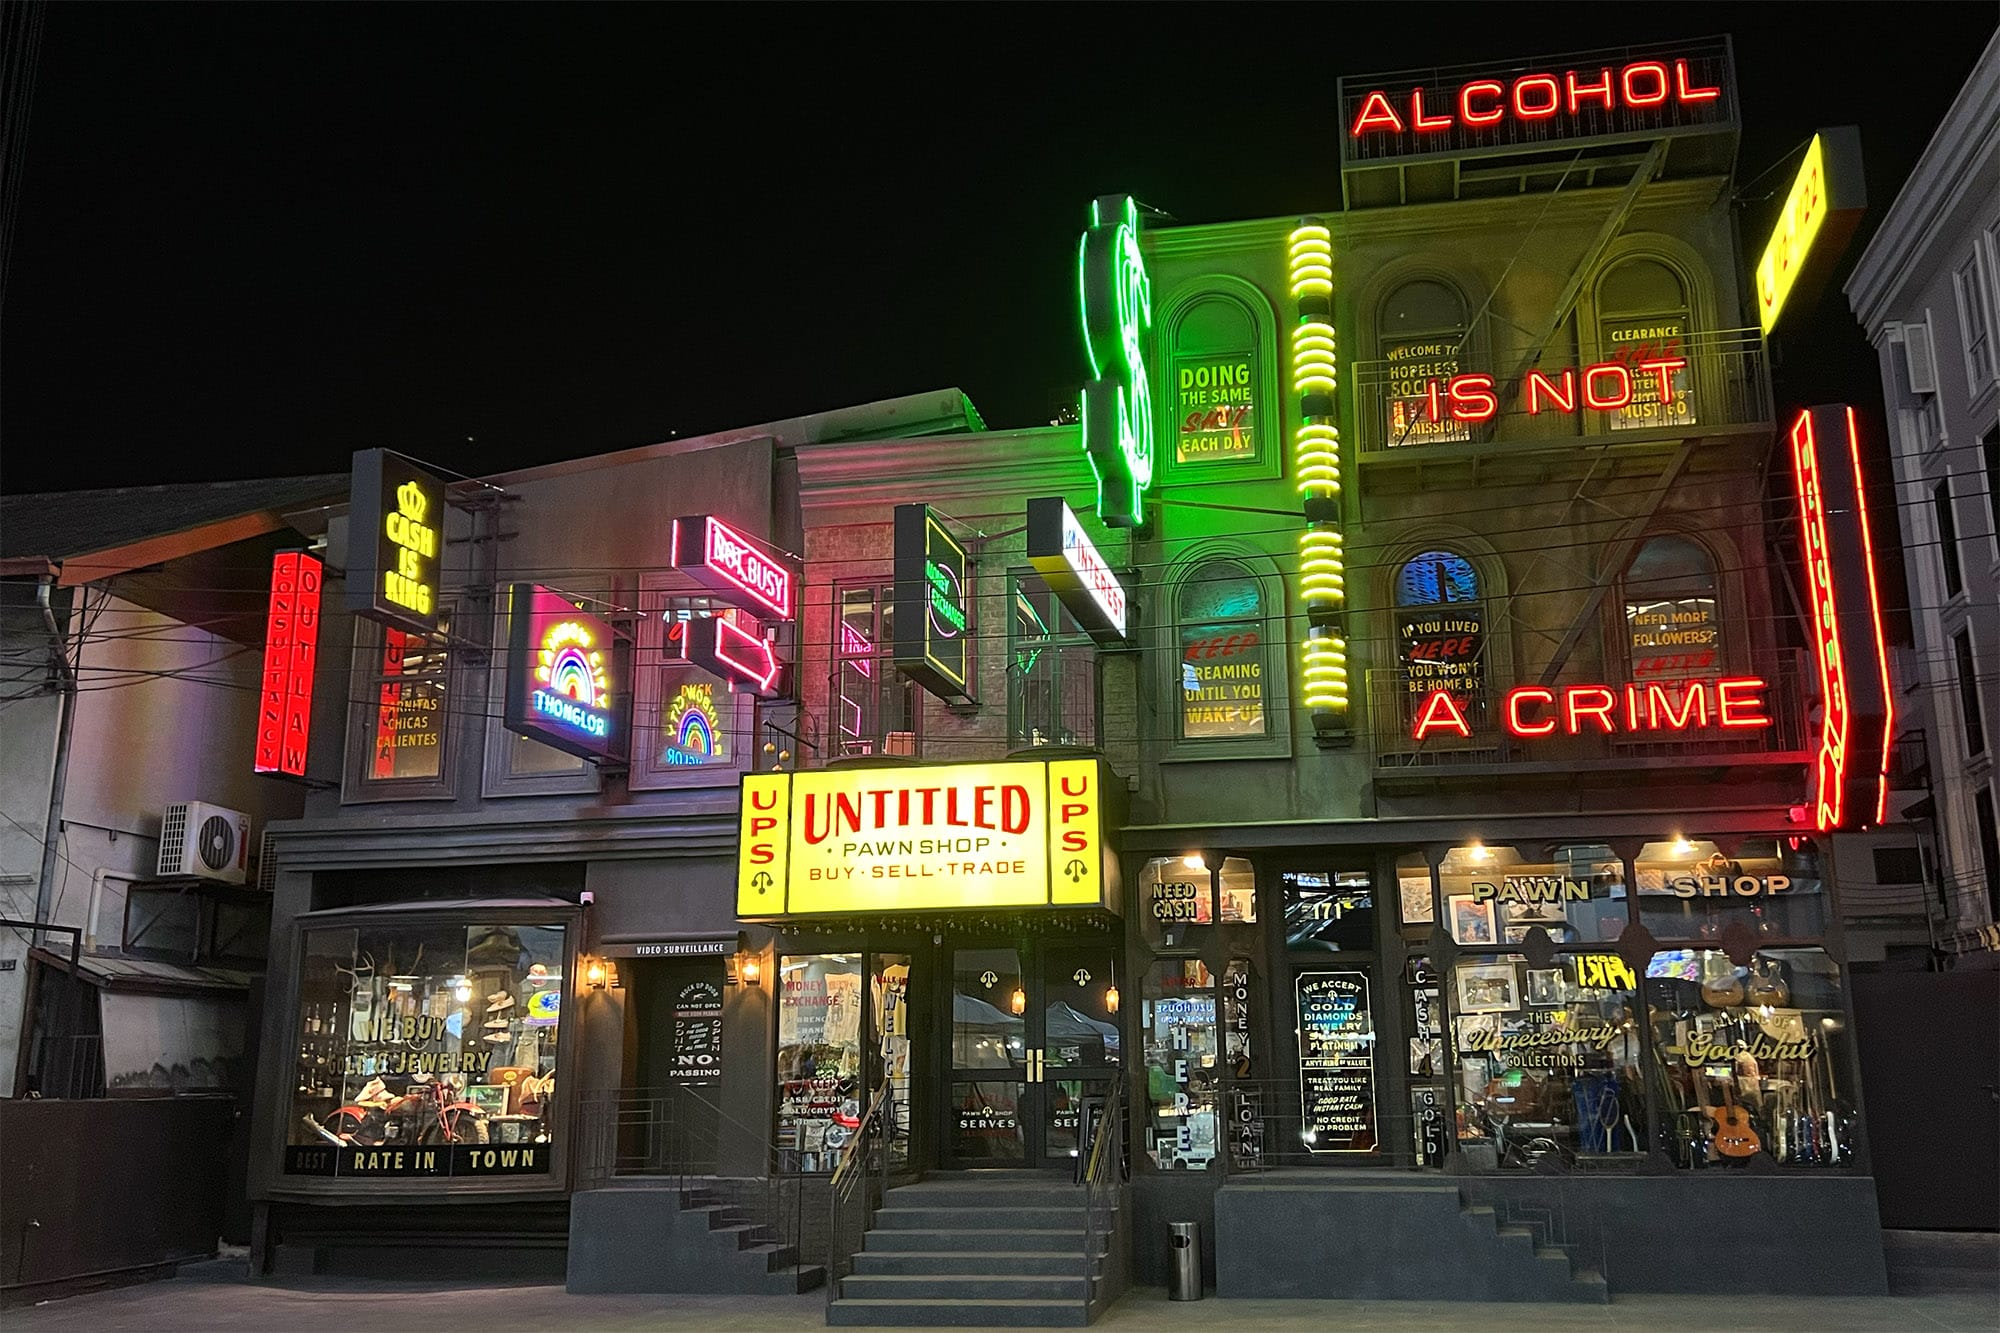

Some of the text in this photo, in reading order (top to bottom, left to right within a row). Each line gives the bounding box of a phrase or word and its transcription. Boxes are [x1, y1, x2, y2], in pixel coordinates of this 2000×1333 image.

[1353, 58, 1721, 137] ALCOHOL
[1611, 326, 1679, 342] CLEARANCE
[1386, 345, 1459, 361] WELCOME TO
[1181, 363, 1250, 389] DOING
[1390, 361, 1459, 379] HOPELESS
[1181, 387, 1251, 405] THE SAME
[1427, 356, 1687, 423] IS NOT
[1620, 401, 1687, 418] MUST GO
[1182, 434, 1251, 453] EACH DAY
[386, 511, 433, 558] CASH
[399, 546, 419, 580] IS
[748, 557, 783, 602] BUSY
[1077, 537, 1123, 621] INTEREST
[385, 570, 430, 615] KING
[931, 587, 965, 631] EXCHANGE
[1671, 611, 1709, 623] MORE
[1416, 621, 1440, 634] YOU
[1445, 620, 1479, 633] LIVED
[1634, 630, 1714, 646] FOLLOWERS?
[1184, 633, 1258, 661] KEEP
[1409, 636, 1474, 660] HERE
[264, 563, 292, 761] CONSULTANCY
[286, 570, 317, 771] OUTLAW
[1193, 664, 1261, 681] REAMING
[1408, 664, 1433, 678] YOU
[1185, 684, 1261, 701] UNTIL YOU
[1409, 678, 1480, 692] BE HOME BY
[381, 699, 438, 713] CARNITAS
[532, 690, 605, 736] THONGLOR
[1187, 703, 1262, 723] WAKE UP
[1413, 675, 1773, 741] A CRIME
[388, 716, 428, 729] CHICAS
[377, 733, 437, 748] CALIENTES
[804, 784, 1031, 845] UNTITLED
[1061, 775, 1089, 852] UPS
[750, 790, 778, 865] UPS
[1153, 883, 1195, 899] NEED
[1472, 874, 1791, 903] PAWN SHOP
[1153, 901, 1195, 918] CASH
[1313, 902, 1341, 920] 171
[636, 943, 724, 955] VIDEO SURVEILLANCE
[680, 983, 695, 999] MOCK
[696, 982, 705, 990] UP
[786, 981, 823, 992] MONEY
[1303, 980, 1362, 994] WE ACCEPT
[785, 995, 840, 1007] EXCHANGE
[1310, 1003, 1356, 1011] GOLD
[1304, 1013, 1363, 1021] DIAMONDS
[1528, 1012, 1551, 1024] THE
[1773, 1015, 1790, 1029] OF
[360, 1014, 448, 1042] WE BUY
[712, 1019, 722, 1052] OPEN
[1305, 1023, 1363, 1031] JEWELRY
[1310, 1041, 1358, 1051] PLATINUM
[1469, 1026, 1617, 1052] Unnecessary
[1685, 1031, 1817, 1067] Goodshit
[328, 1050, 492, 1076] GOLD & JEWELRY
[678, 1055, 713, 1065] NO
[1234, 973, 1253, 1154] MONEY 2 LOAN
[1416, 970, 1437, 1154] CASH 4 GOLD
[1506, 1055, 1586, 1067] COLLECTIONS
[669, 1069, 721, 1077] PASSING
[1173, 1026, 1190, 1149] HERE
[1339, 1095, 1358, 1103] RATE
[1313, 1104, 1344, 1112] INSTANT
[960, 1119, 1016, 1129] SERVES
[1312, 1124, 1326, 1132] NO
[1317, 1116, 1329, 1124] NO
[296, 1149, 535, 1170] BEST RATE IN TOWN
